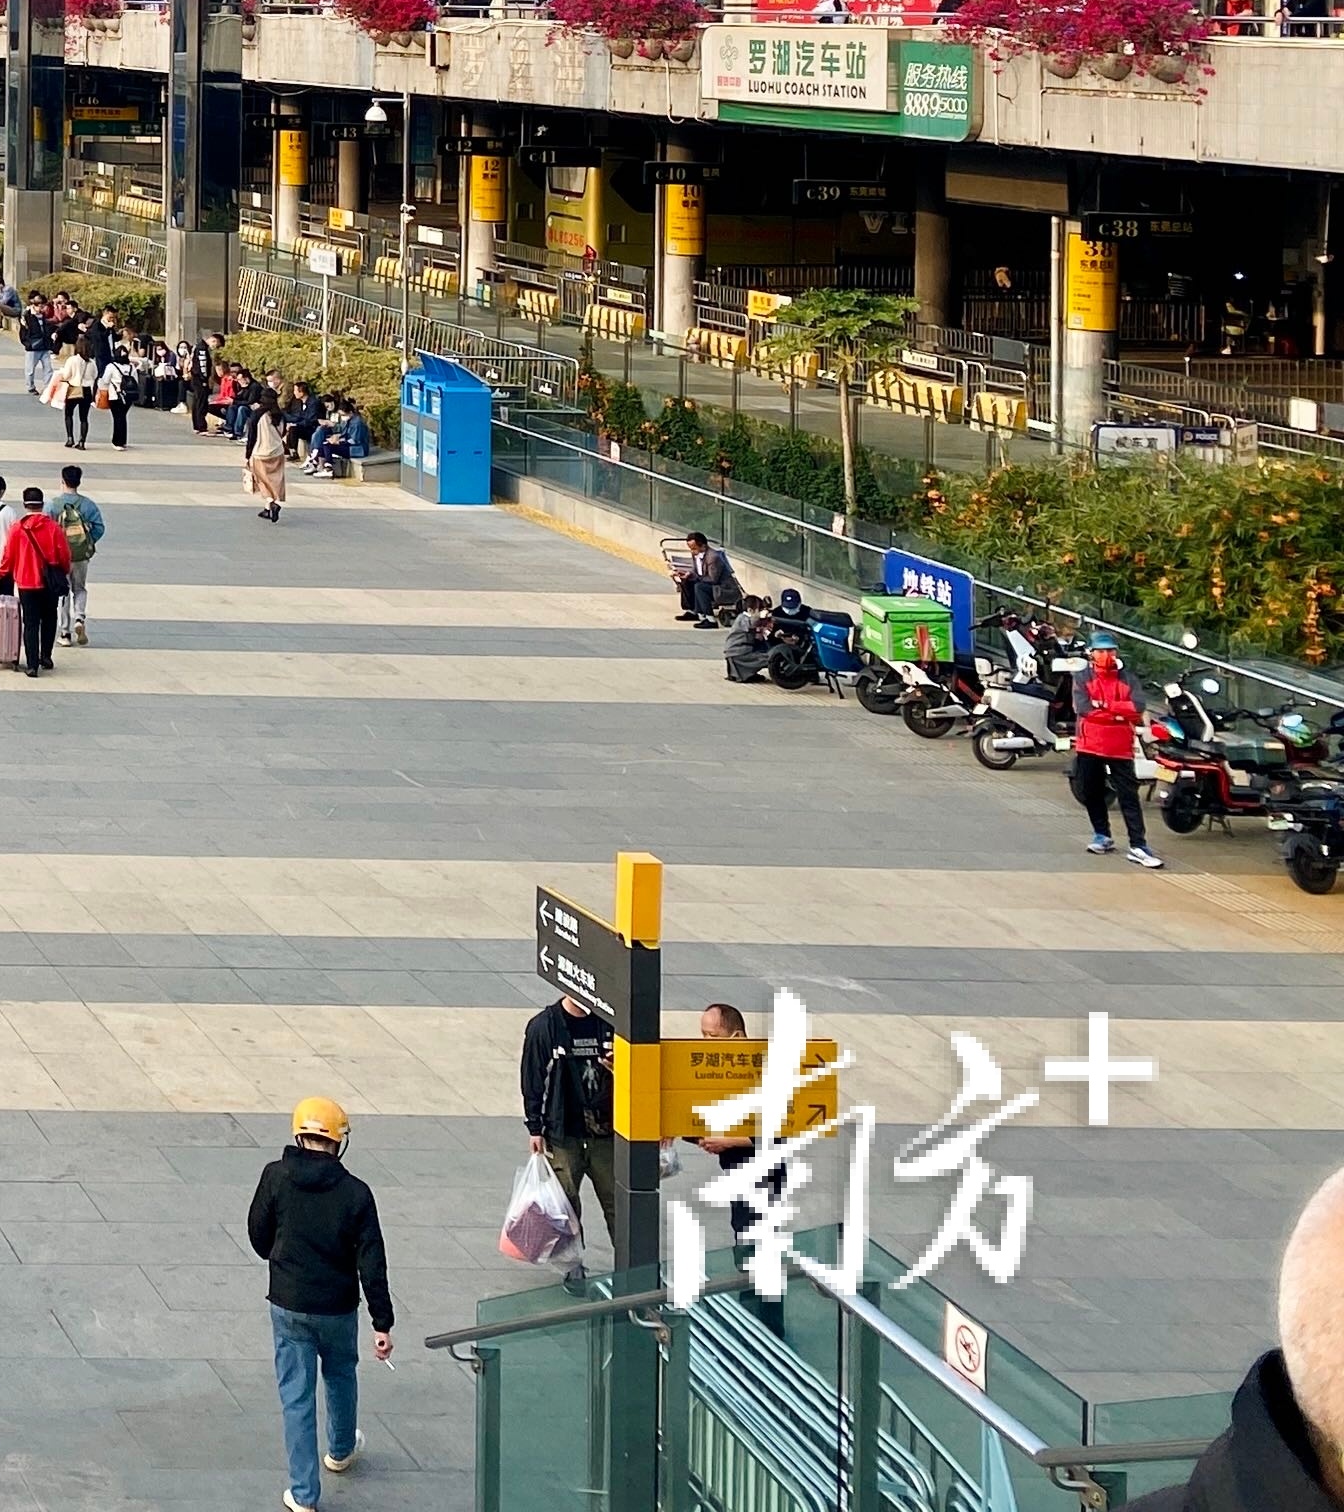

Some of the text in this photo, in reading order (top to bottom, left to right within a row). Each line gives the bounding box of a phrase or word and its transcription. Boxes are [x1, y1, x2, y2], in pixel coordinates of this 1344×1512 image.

[748, 39, 867, 80] 罗湖汽车站
[748, 79, 782, 96] LUOHU
[784, 81, 820, 97] COACH
[821, 83, 867, 99] STATION
[904, 62, 968, 90] 服务热线
[858, 210, 916, 234] VI
[902, 567, 953, 608] 地铁站
[694, 1070, 724, 1080] Luohu
[725, 1070, 755, 1080] Coach
